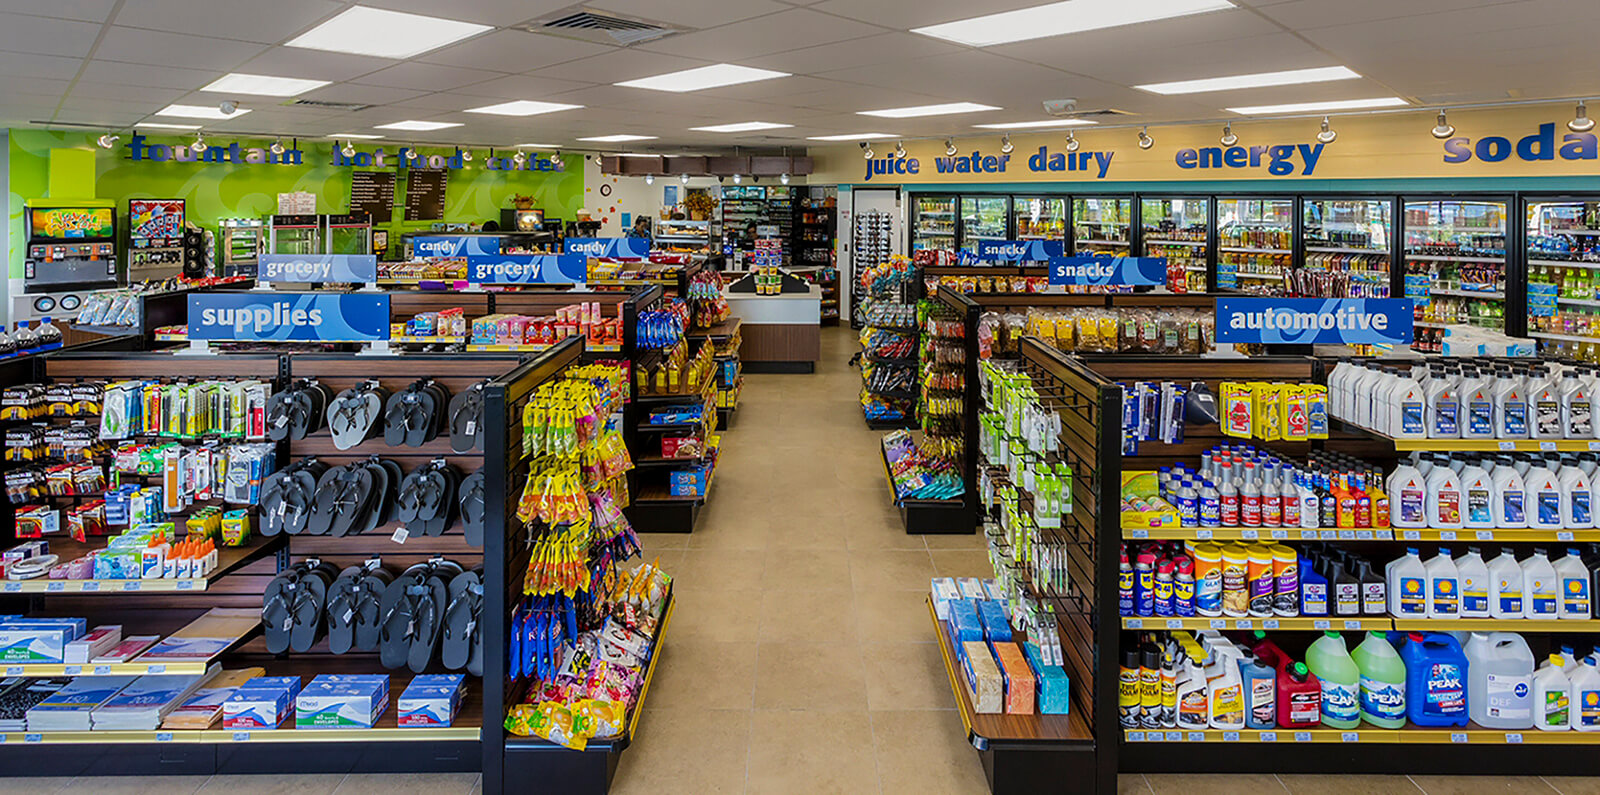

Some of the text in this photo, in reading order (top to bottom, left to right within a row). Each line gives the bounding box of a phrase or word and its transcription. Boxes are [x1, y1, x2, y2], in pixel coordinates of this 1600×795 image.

[128, 134, 303, 166] fountain
[1443, 122, 1599, 164] soda
[332, 143, 464, 170] hot food
[486, 152, 565, 173] coffee
[865, 150, 1011, 181] juice water
[1028, 146, 1114, 179] dairy
[1175, 142, 1326, 176] energy
[419, 240, 457, 254] candy
[570, 241, 607, 255] candy
[984, 243, 1026, 256] snacks
[266, 260, 331, 279] grocery
[476, 261, 541, 283] grocery
[1057, 262, 1114, 278] snacks
[201, 302, 323, 333] supplies
[1230, 307, 1388, 331] automotive
[1427, 678, 1463, 692] PEAK
[1367, 689, 1405, 705] PEAK
[1490, 696, 1513, 707] DEF
